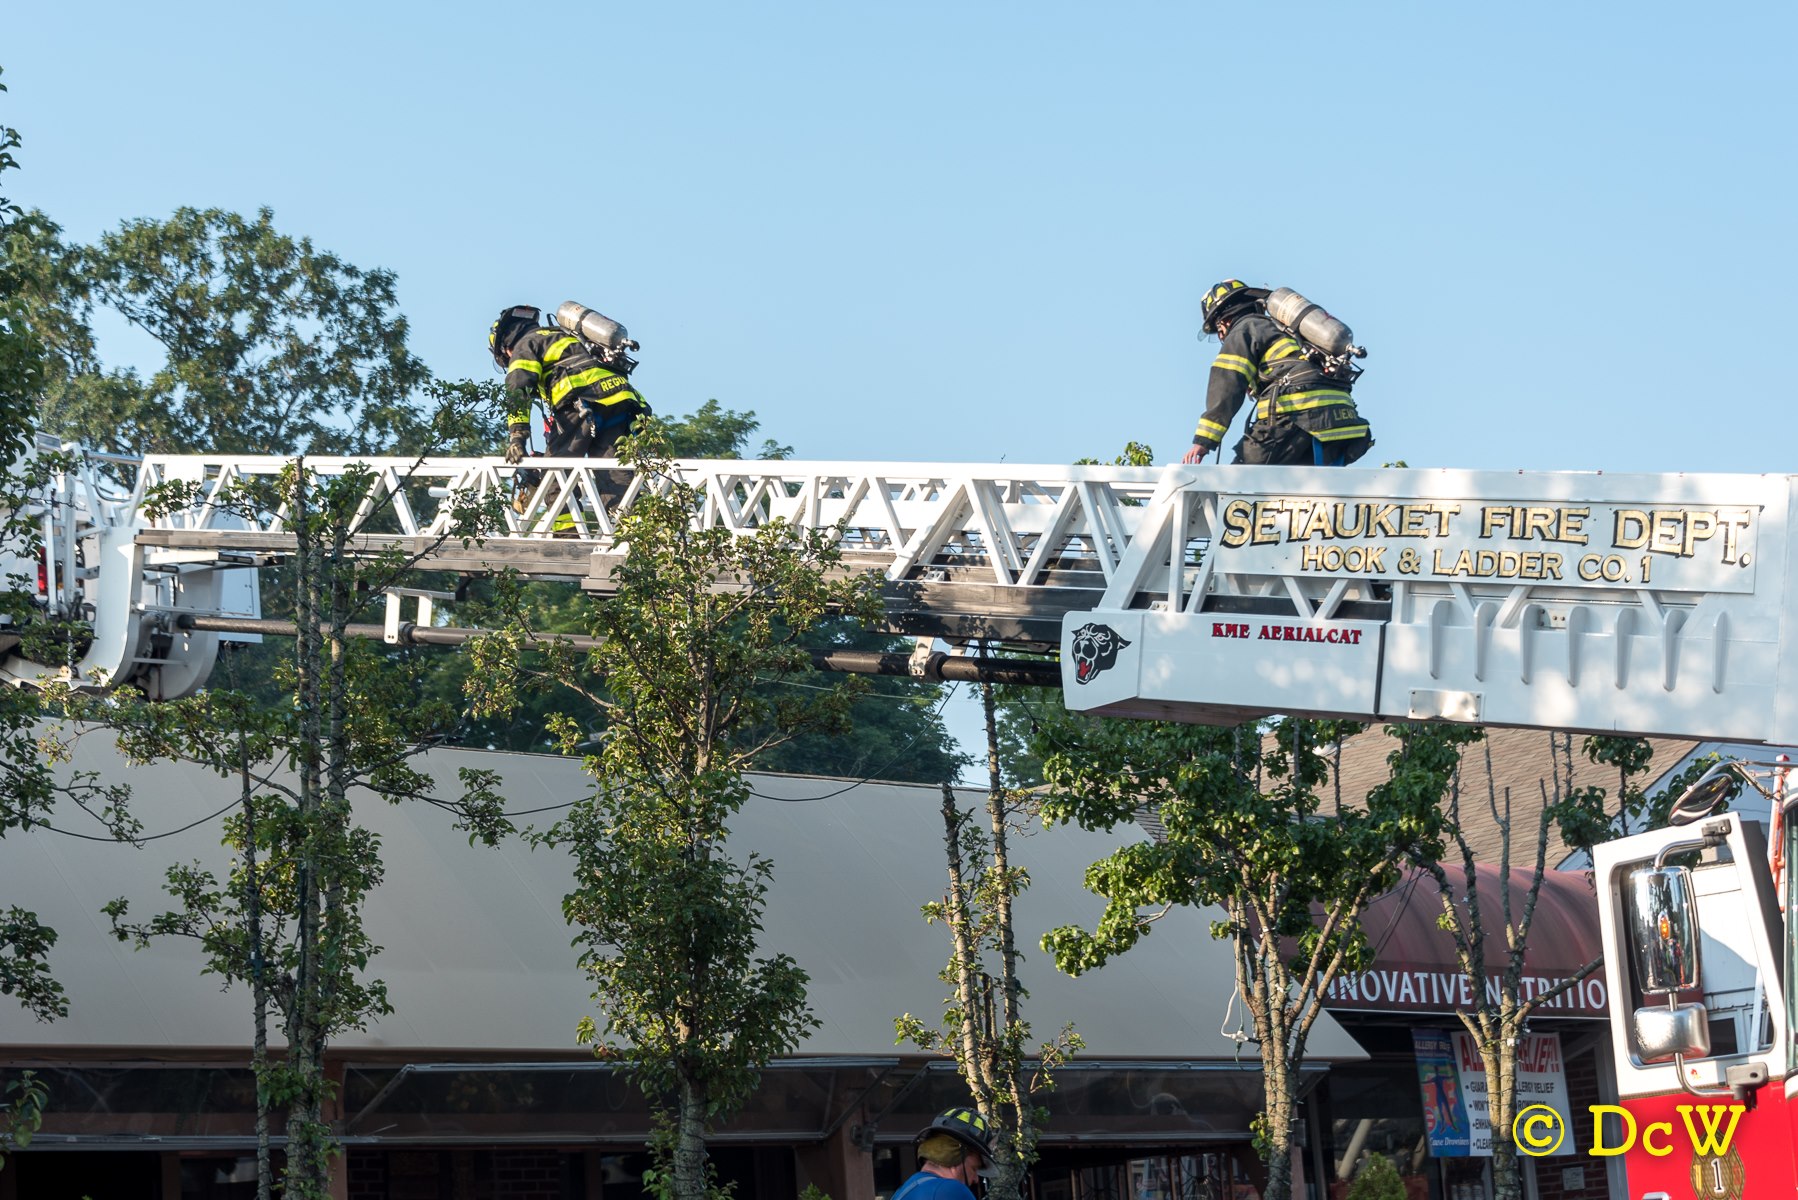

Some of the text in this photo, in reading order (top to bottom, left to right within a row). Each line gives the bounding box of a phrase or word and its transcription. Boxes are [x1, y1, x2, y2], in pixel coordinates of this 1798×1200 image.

[1220, 498, 1753, 569] SETAUKET FIRE DEPT.
[1301, 544, 1388, 575] HOOK
[1398, 548, 1421, 575] &
[1432, 548, 1564, 581] LADDER
[1211, 622, 1363, 645] KME AERIALCAT
[1316, 970, 1606, 1010] NNOVATIVE NTRITIO
